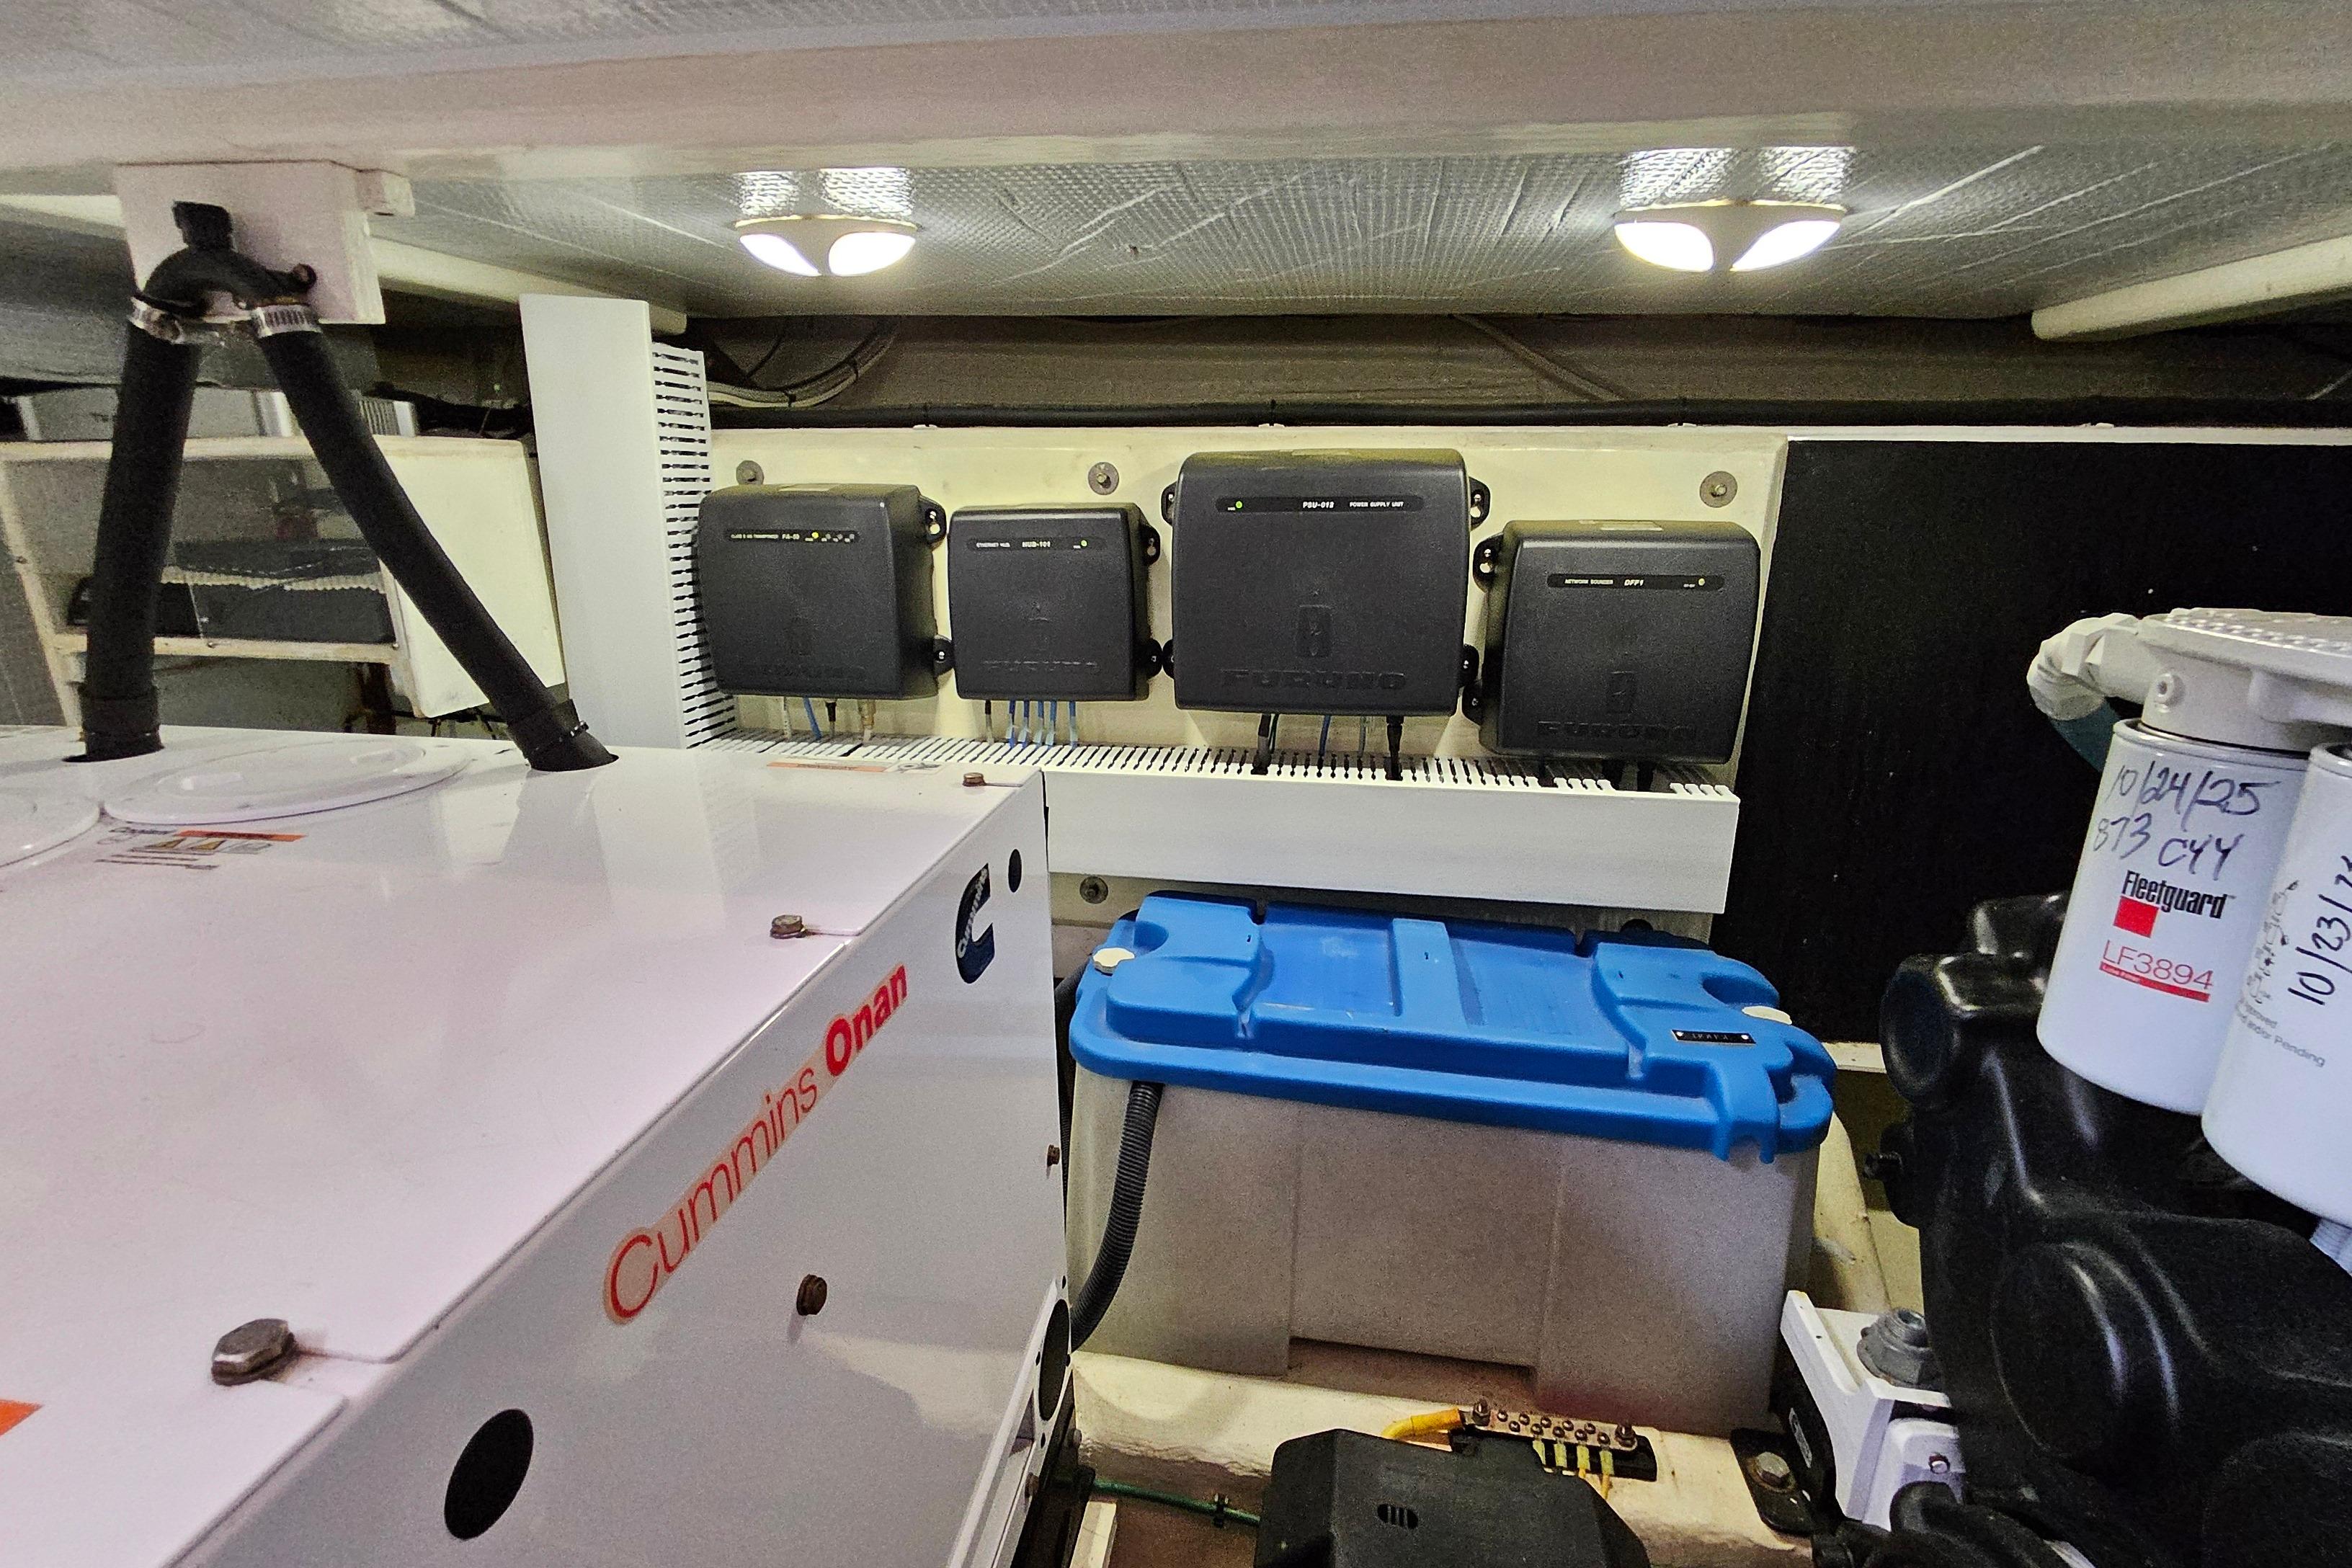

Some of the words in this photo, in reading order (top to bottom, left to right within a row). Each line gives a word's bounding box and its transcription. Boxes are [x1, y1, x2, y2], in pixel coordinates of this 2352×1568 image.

[2105, 761, 2281, 832] 10/24/25
[2093, 813, 2152, 859] 873
[2121, 870, 2228, 919] Fleetguard
[2103, 940, 2214, 989] LF3894
[2274, 1035, 2325, 1067] Pending
[610, 1067, 818, 1318] Cummins
[826, 964, 907, 1076] Onan
